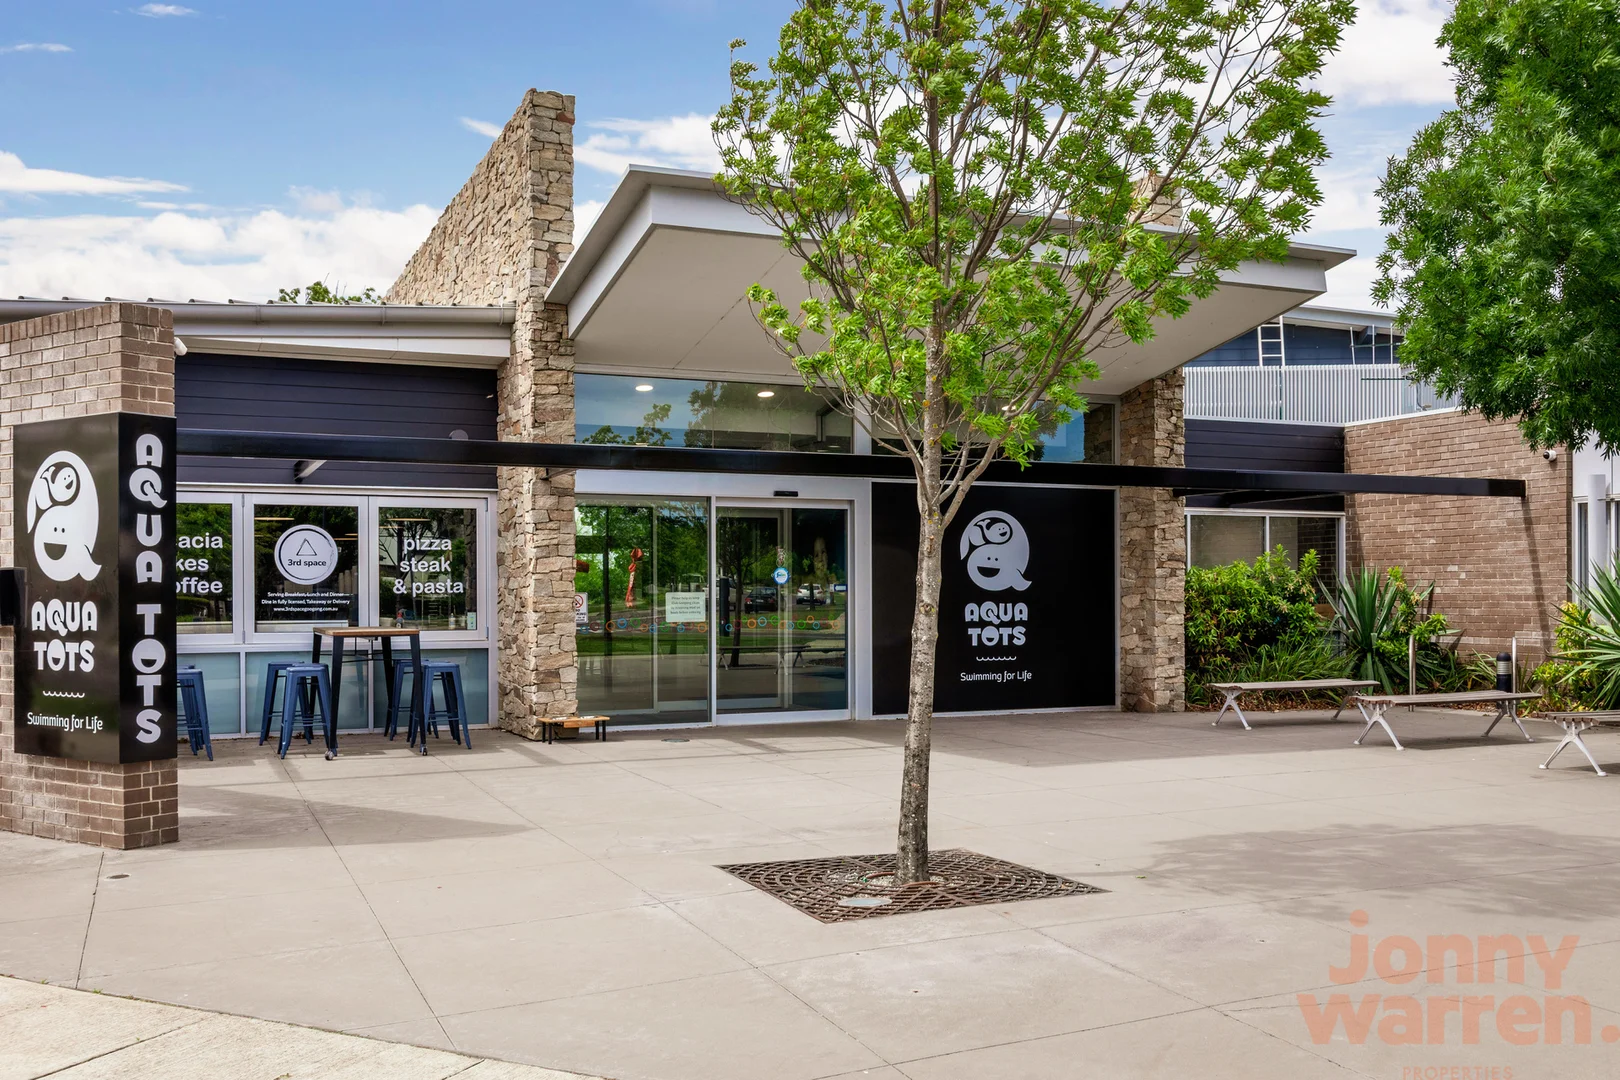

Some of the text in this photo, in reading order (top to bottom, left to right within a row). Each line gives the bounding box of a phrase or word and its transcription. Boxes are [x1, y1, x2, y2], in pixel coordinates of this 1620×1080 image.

[176, 532, 223, 549] acia
[403, 535, 452, 554] pizza
[287, 558, 327, 568] 3rd space
[399, 556, 452, 573] steak
[129, 433, 168, 744] AQUA TOTS
[392, 578, 464, 598] & pasta
[31, 598, 98, 637] AQUA
[964, 601, 1029, 625] AQUA
[967, 626, 1027, 647] TOTS
[33, 638, 95, 673] TOTS
[960, 670, 1033, 683] Swimming for Life
[27, 711, 103, 734] Swimming for Life
